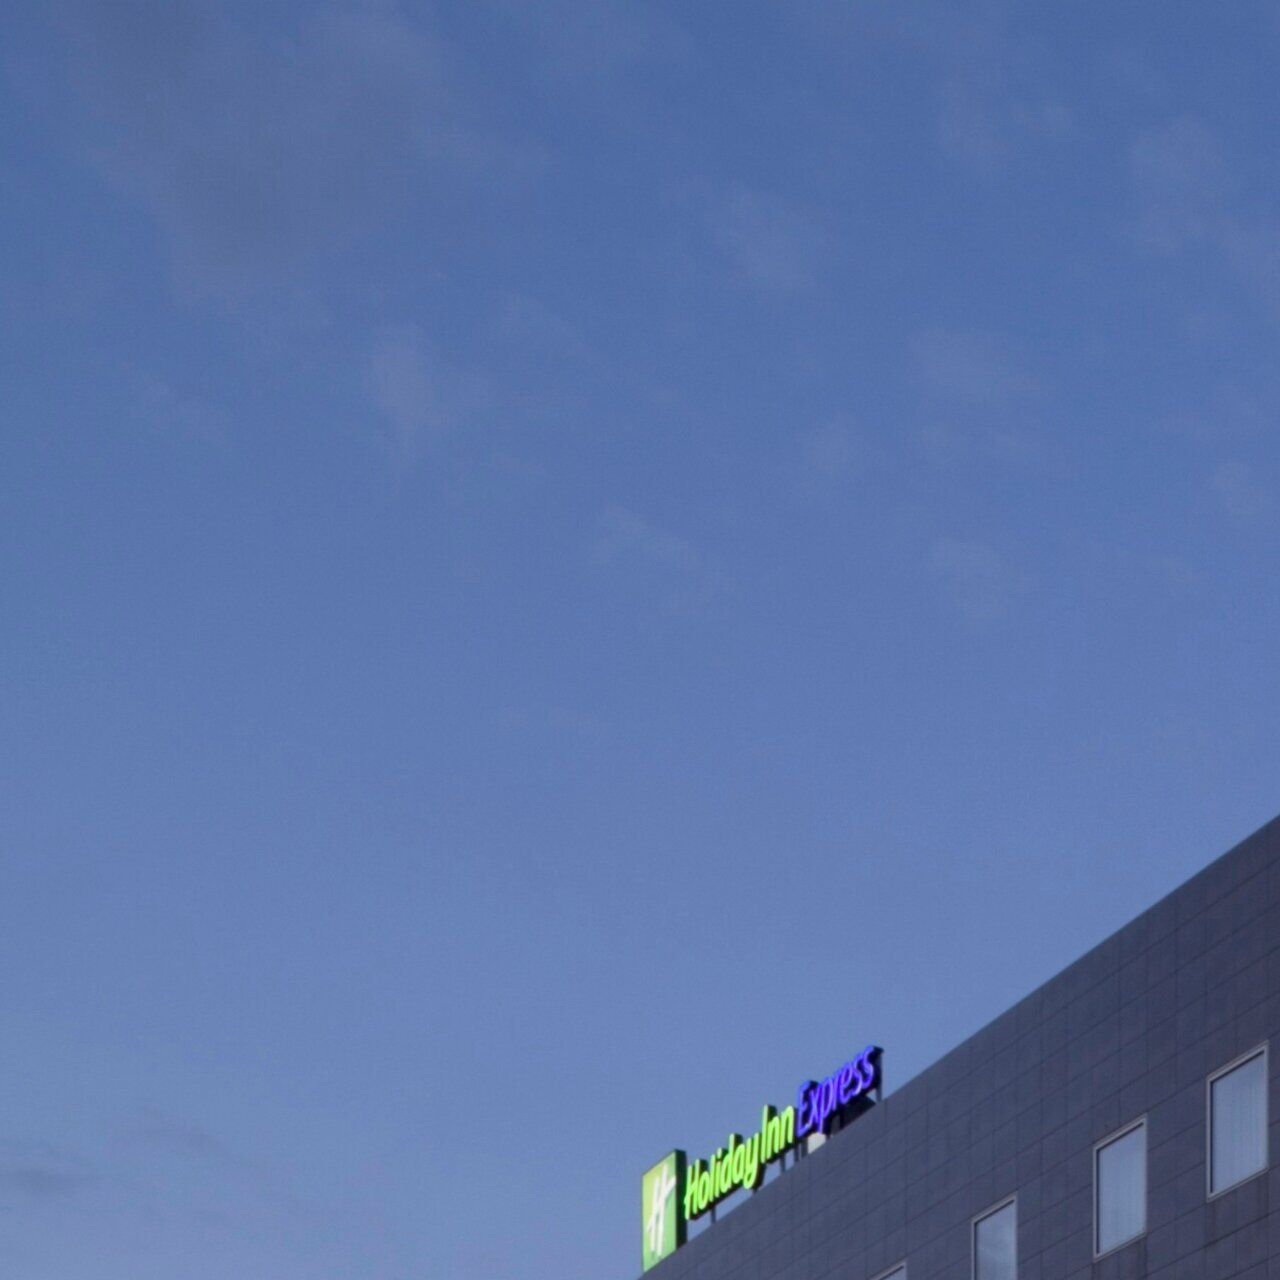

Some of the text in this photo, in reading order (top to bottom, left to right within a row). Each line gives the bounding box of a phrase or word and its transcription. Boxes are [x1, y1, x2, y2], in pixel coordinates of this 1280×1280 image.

[684, 1045, 874, 1220] Holiday Inn Express
